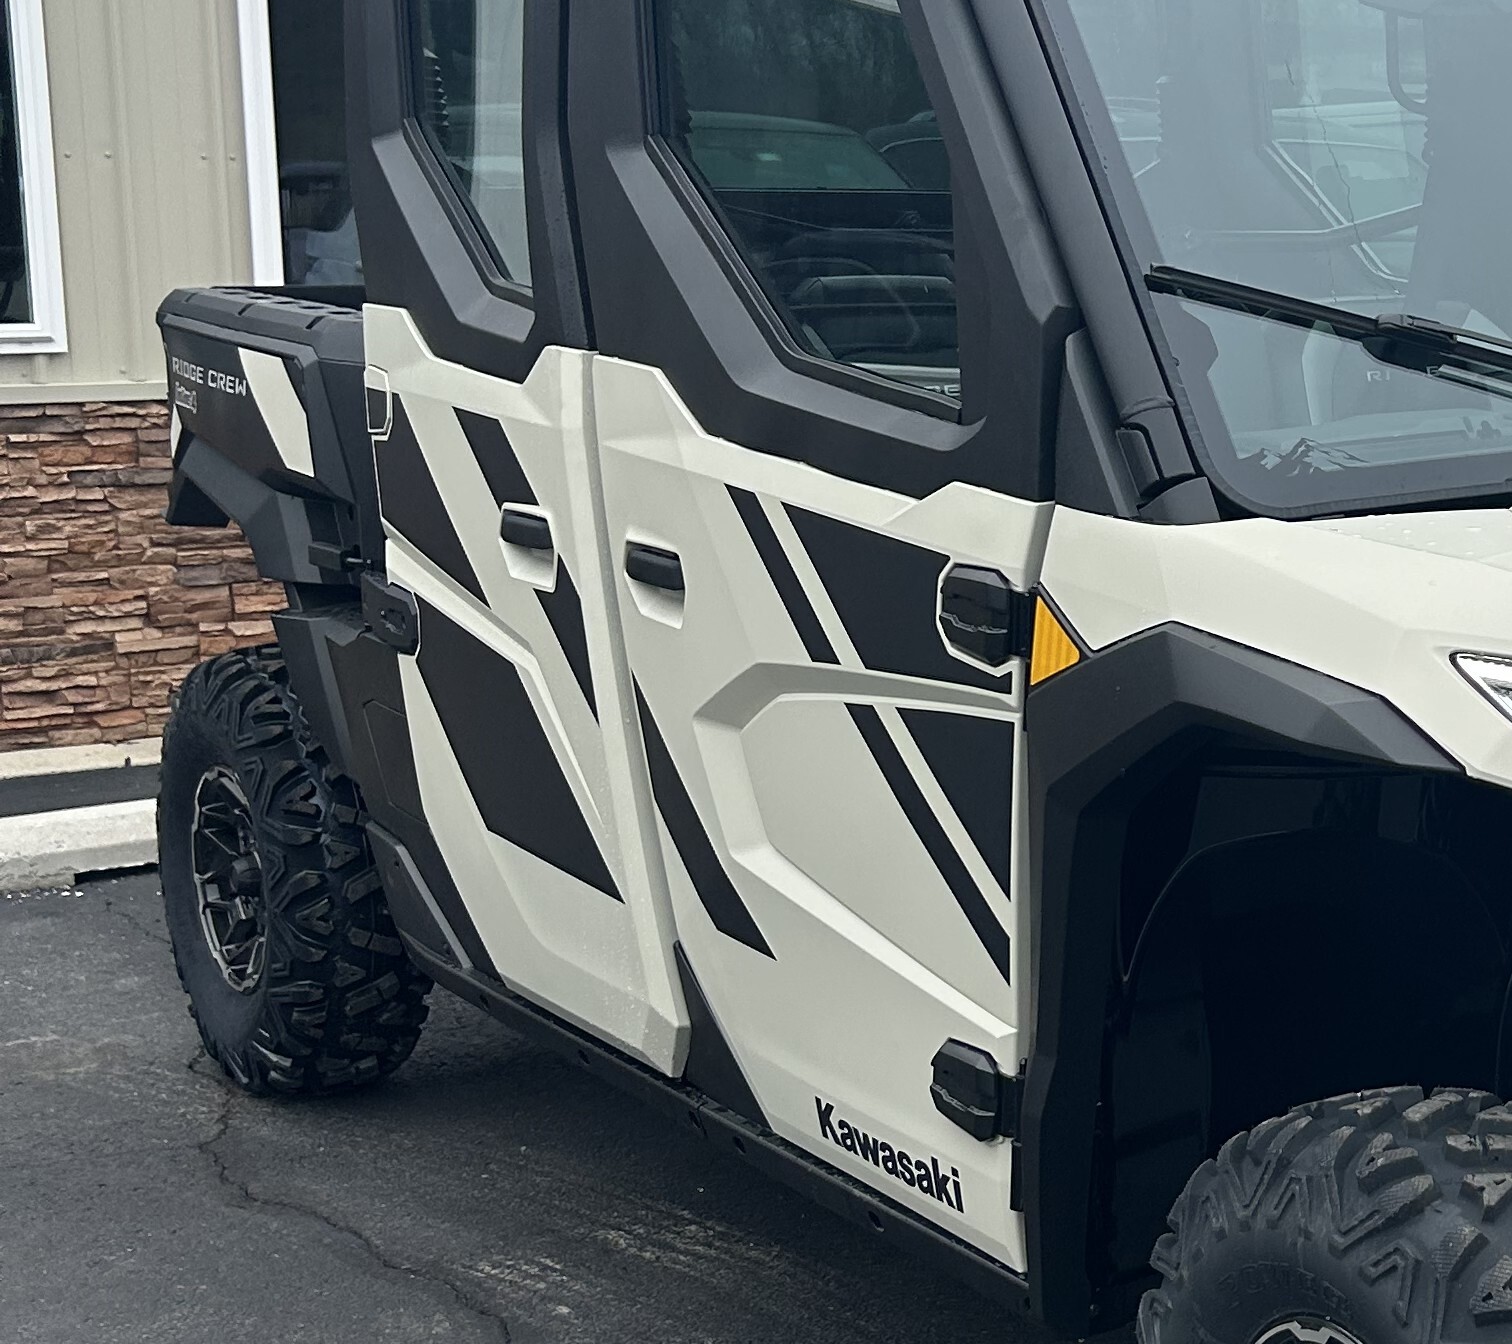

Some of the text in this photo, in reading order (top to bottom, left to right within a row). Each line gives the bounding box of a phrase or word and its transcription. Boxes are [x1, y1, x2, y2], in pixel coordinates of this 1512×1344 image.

[172, 356, 247, 396] RIDGE CREW
[814, 1096, 965, 1214] Kawasaki
